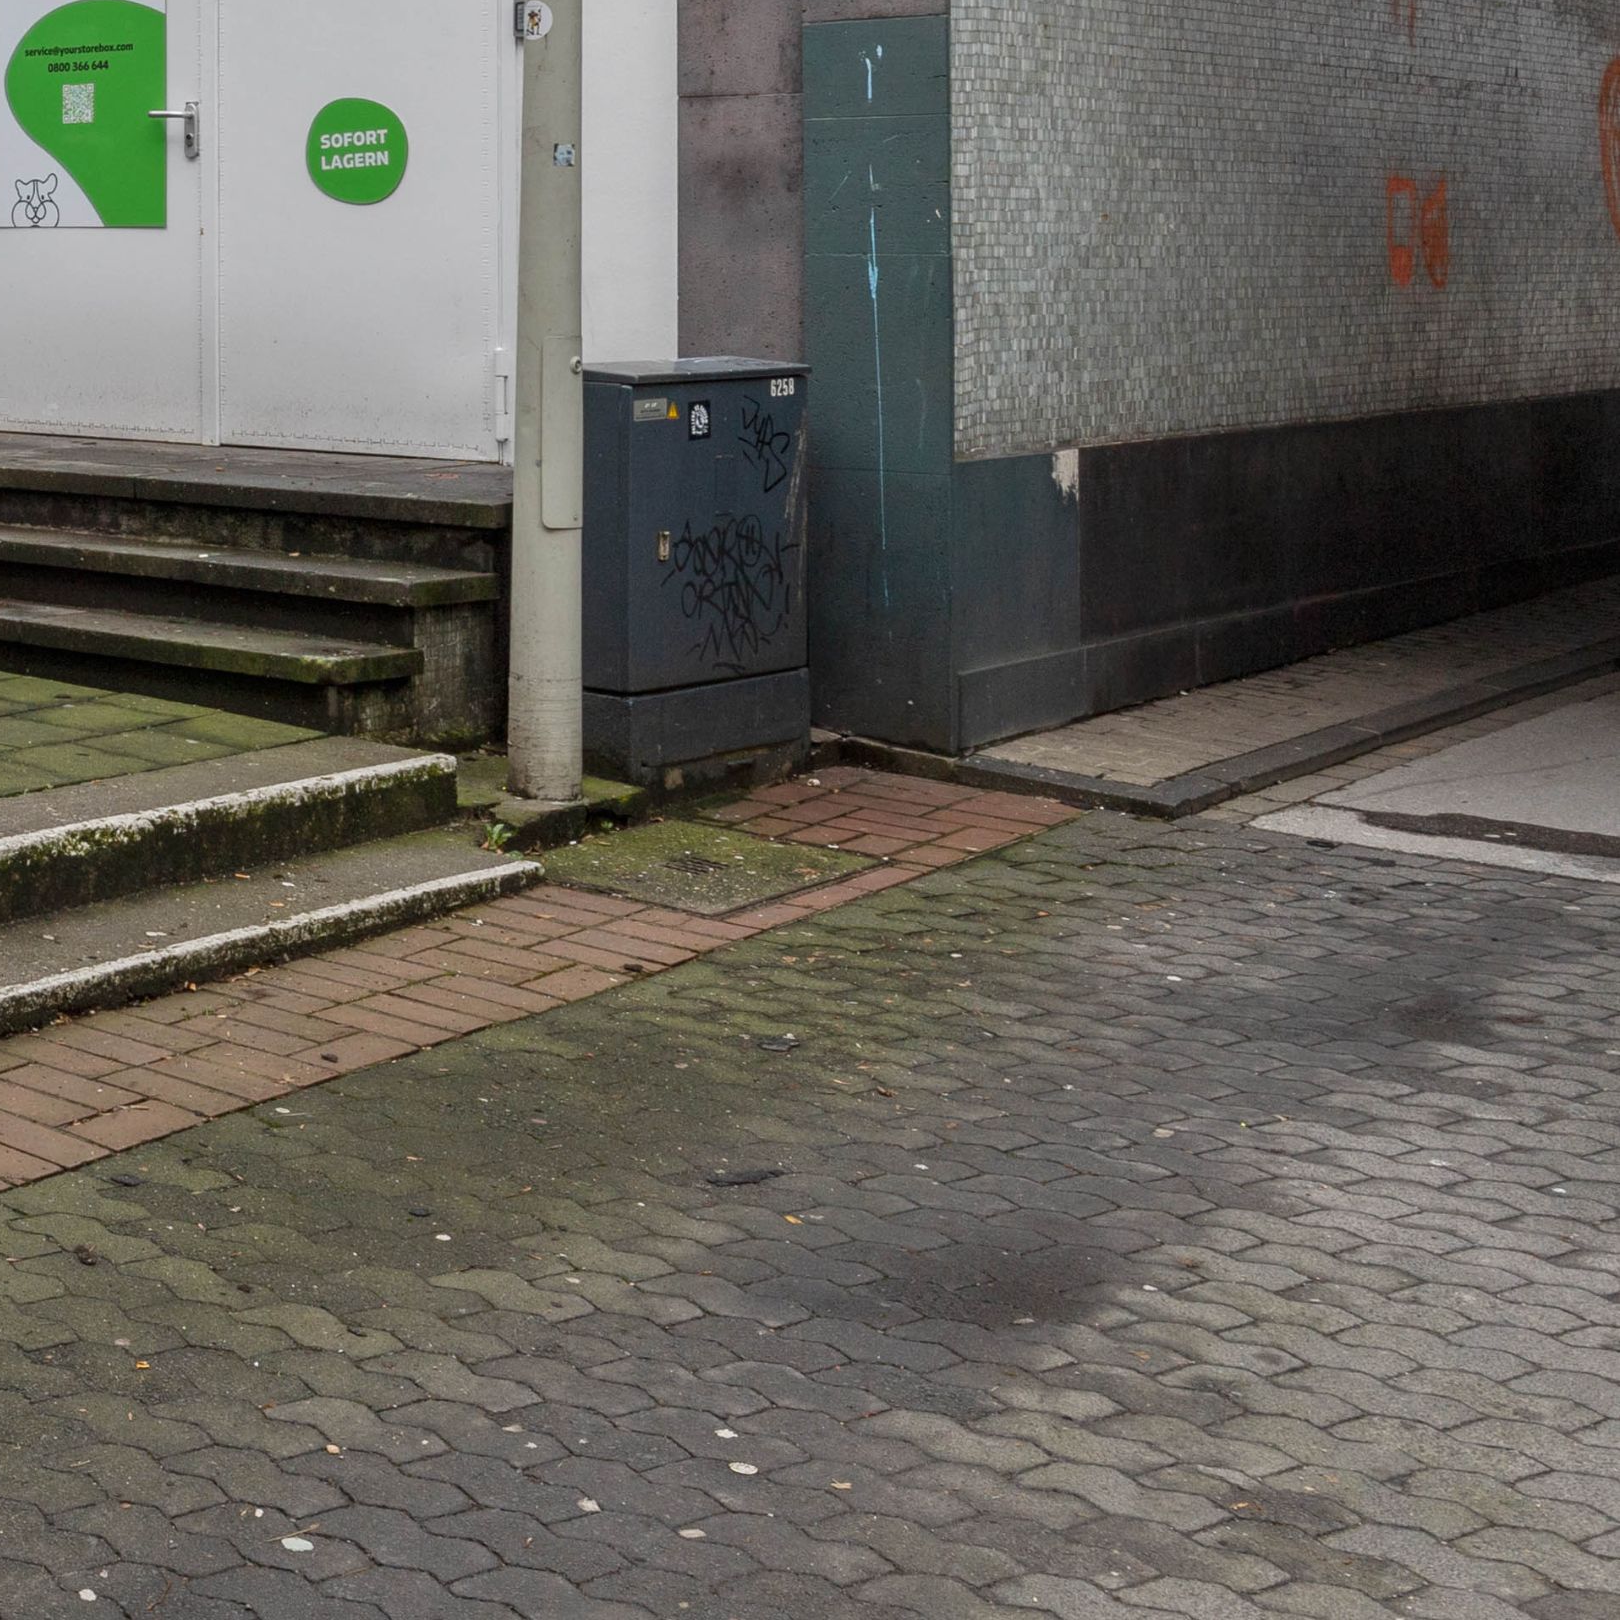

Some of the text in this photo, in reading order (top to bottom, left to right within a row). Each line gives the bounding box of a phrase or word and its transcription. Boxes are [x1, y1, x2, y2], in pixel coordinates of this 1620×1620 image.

[24, 42, 134, 57] service@yourstorebox.com
[47, 60, 109, 73] 0800 366 644
[320, 129, 388, 149] SOFORT
[321, 150, 389, 171] LAGERN
[770, 377, 795, 397] 6258
